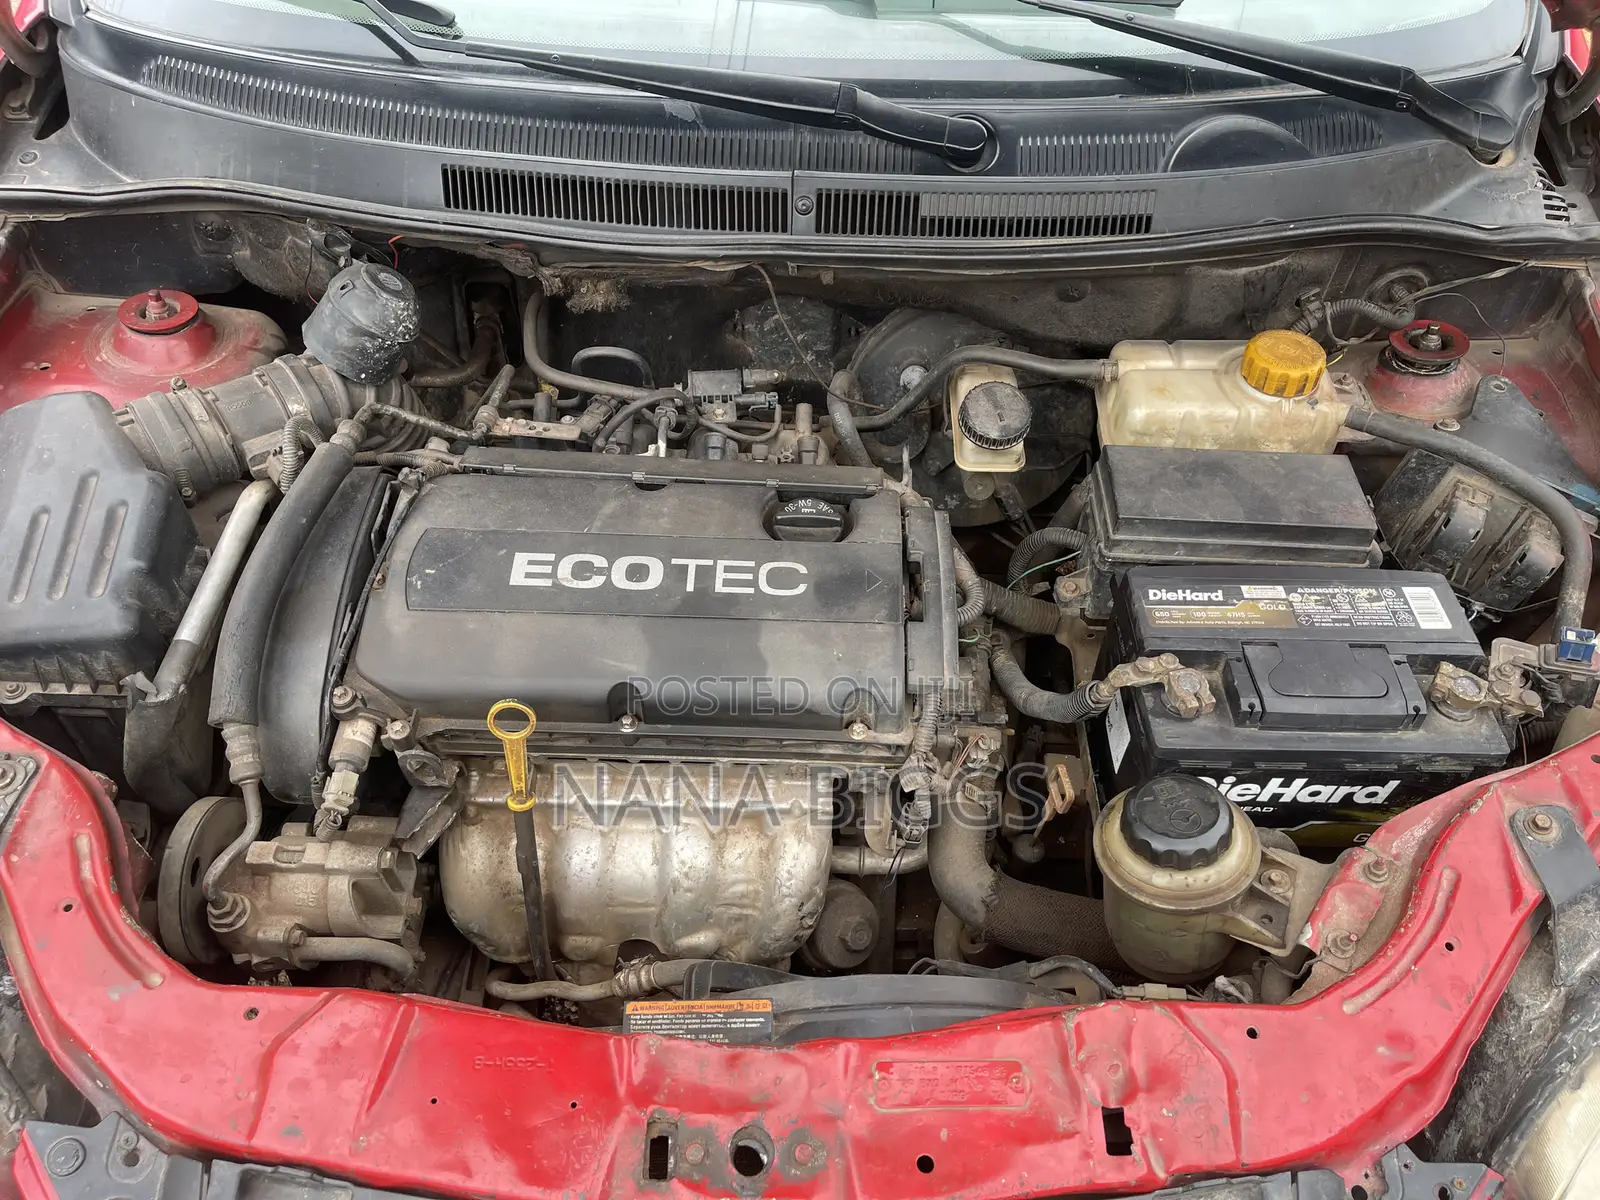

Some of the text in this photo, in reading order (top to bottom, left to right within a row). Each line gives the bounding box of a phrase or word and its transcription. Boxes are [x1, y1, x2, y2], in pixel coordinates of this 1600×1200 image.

[508, 551, 809, 596] ECOTEC
[1147, 588, 1224, 601] DieHard
[1197, 775, 1401, 805] ieHard
